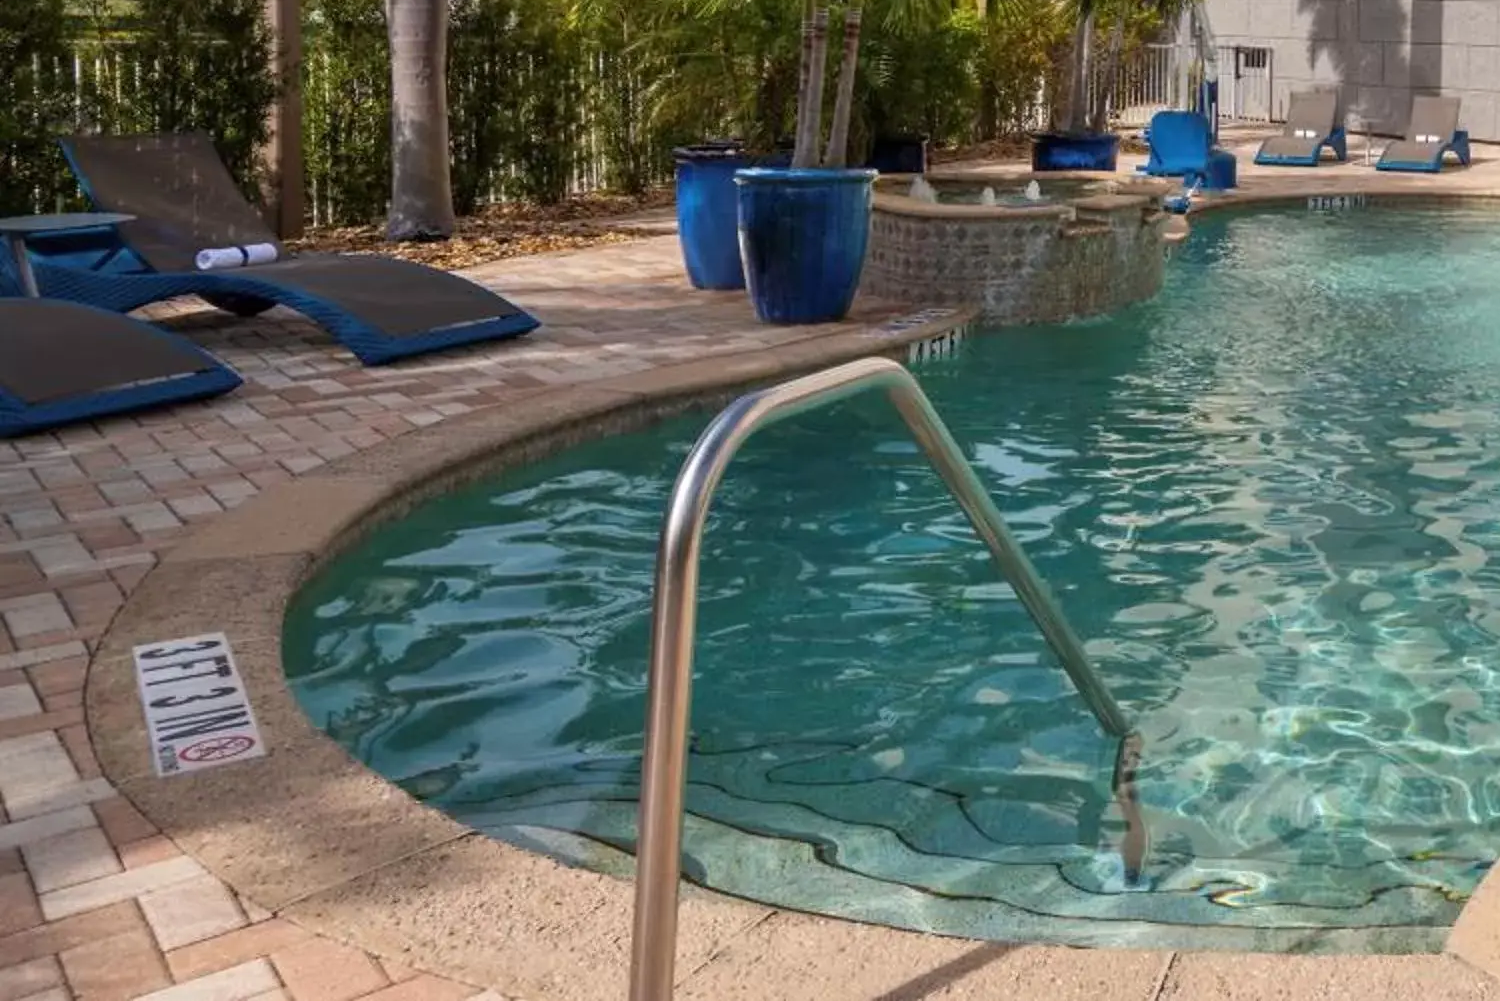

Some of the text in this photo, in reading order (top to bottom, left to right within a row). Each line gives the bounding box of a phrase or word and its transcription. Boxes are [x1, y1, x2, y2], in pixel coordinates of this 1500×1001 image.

[140, 640, 250, 742] 3 FT 3 IN
